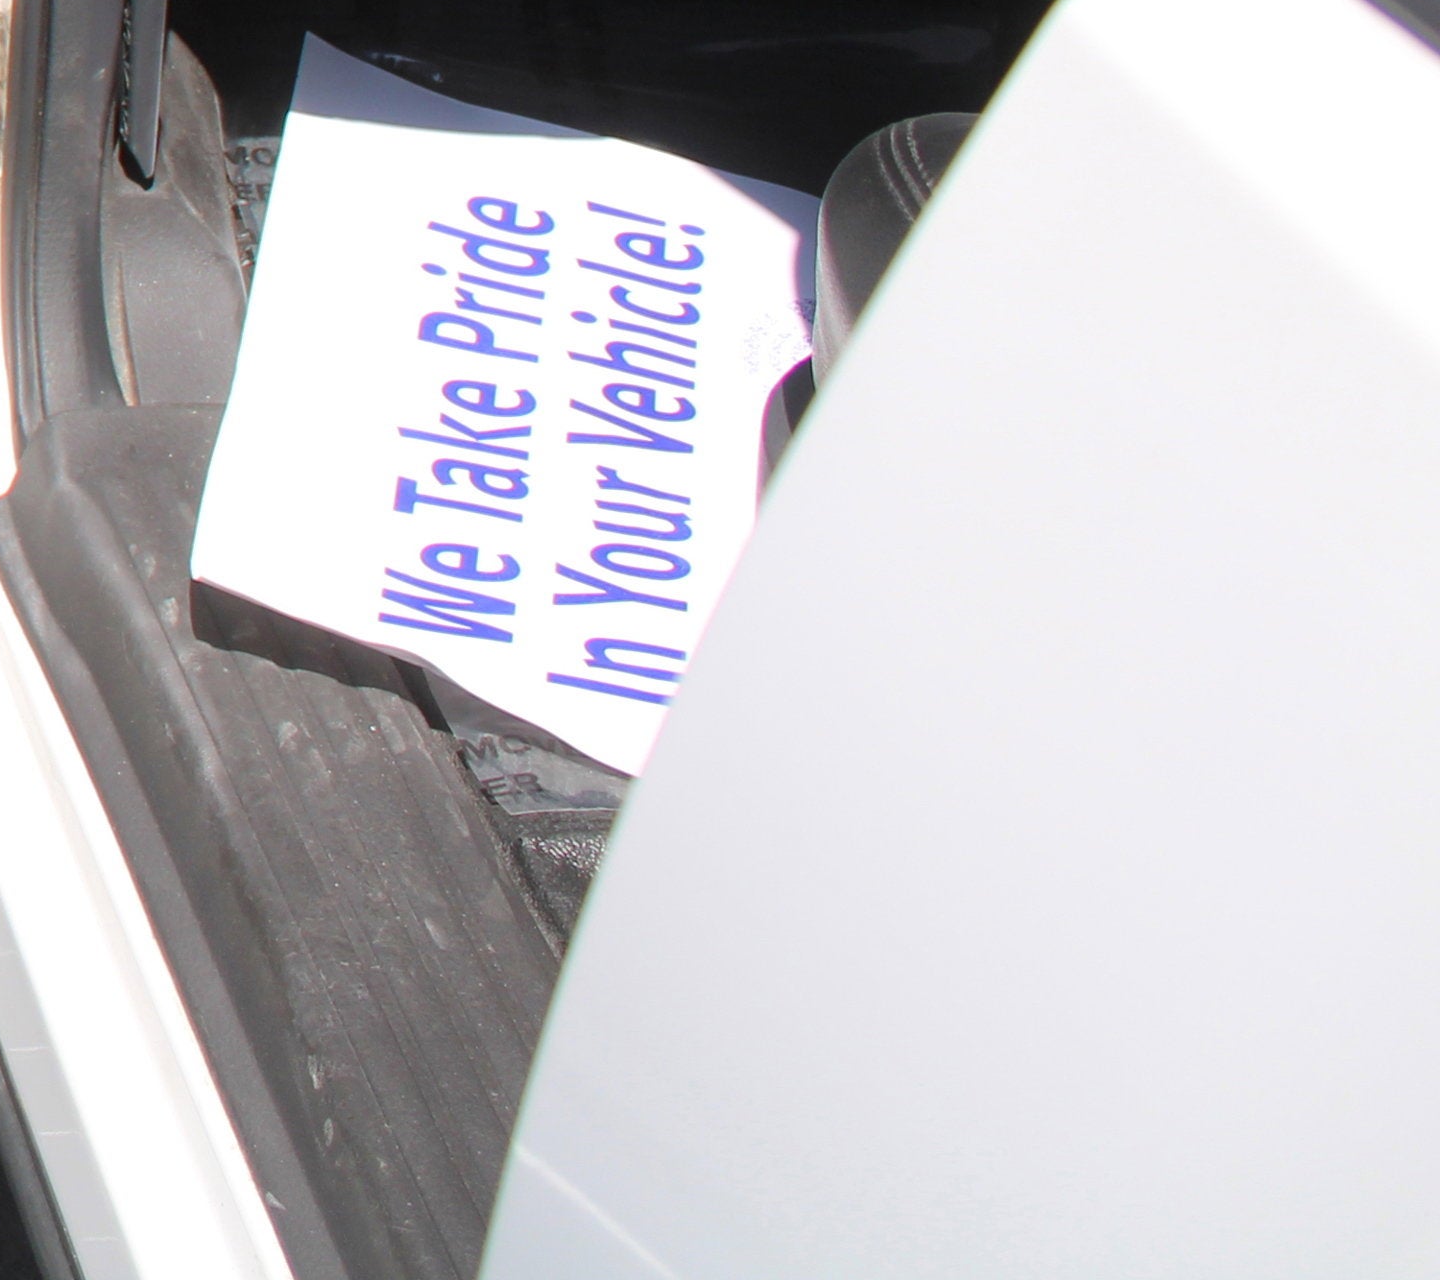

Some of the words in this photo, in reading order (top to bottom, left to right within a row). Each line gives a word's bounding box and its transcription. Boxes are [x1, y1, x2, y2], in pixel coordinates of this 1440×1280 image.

[417, 196, 555, 363] Pride
[566, 201, 706, 454] Vehicle!
[392, 379, 537, 523] Take
[378, 542, 521, 643] We
[552, 465, 692, 612] Your
[546, 638, 687, 706] In
